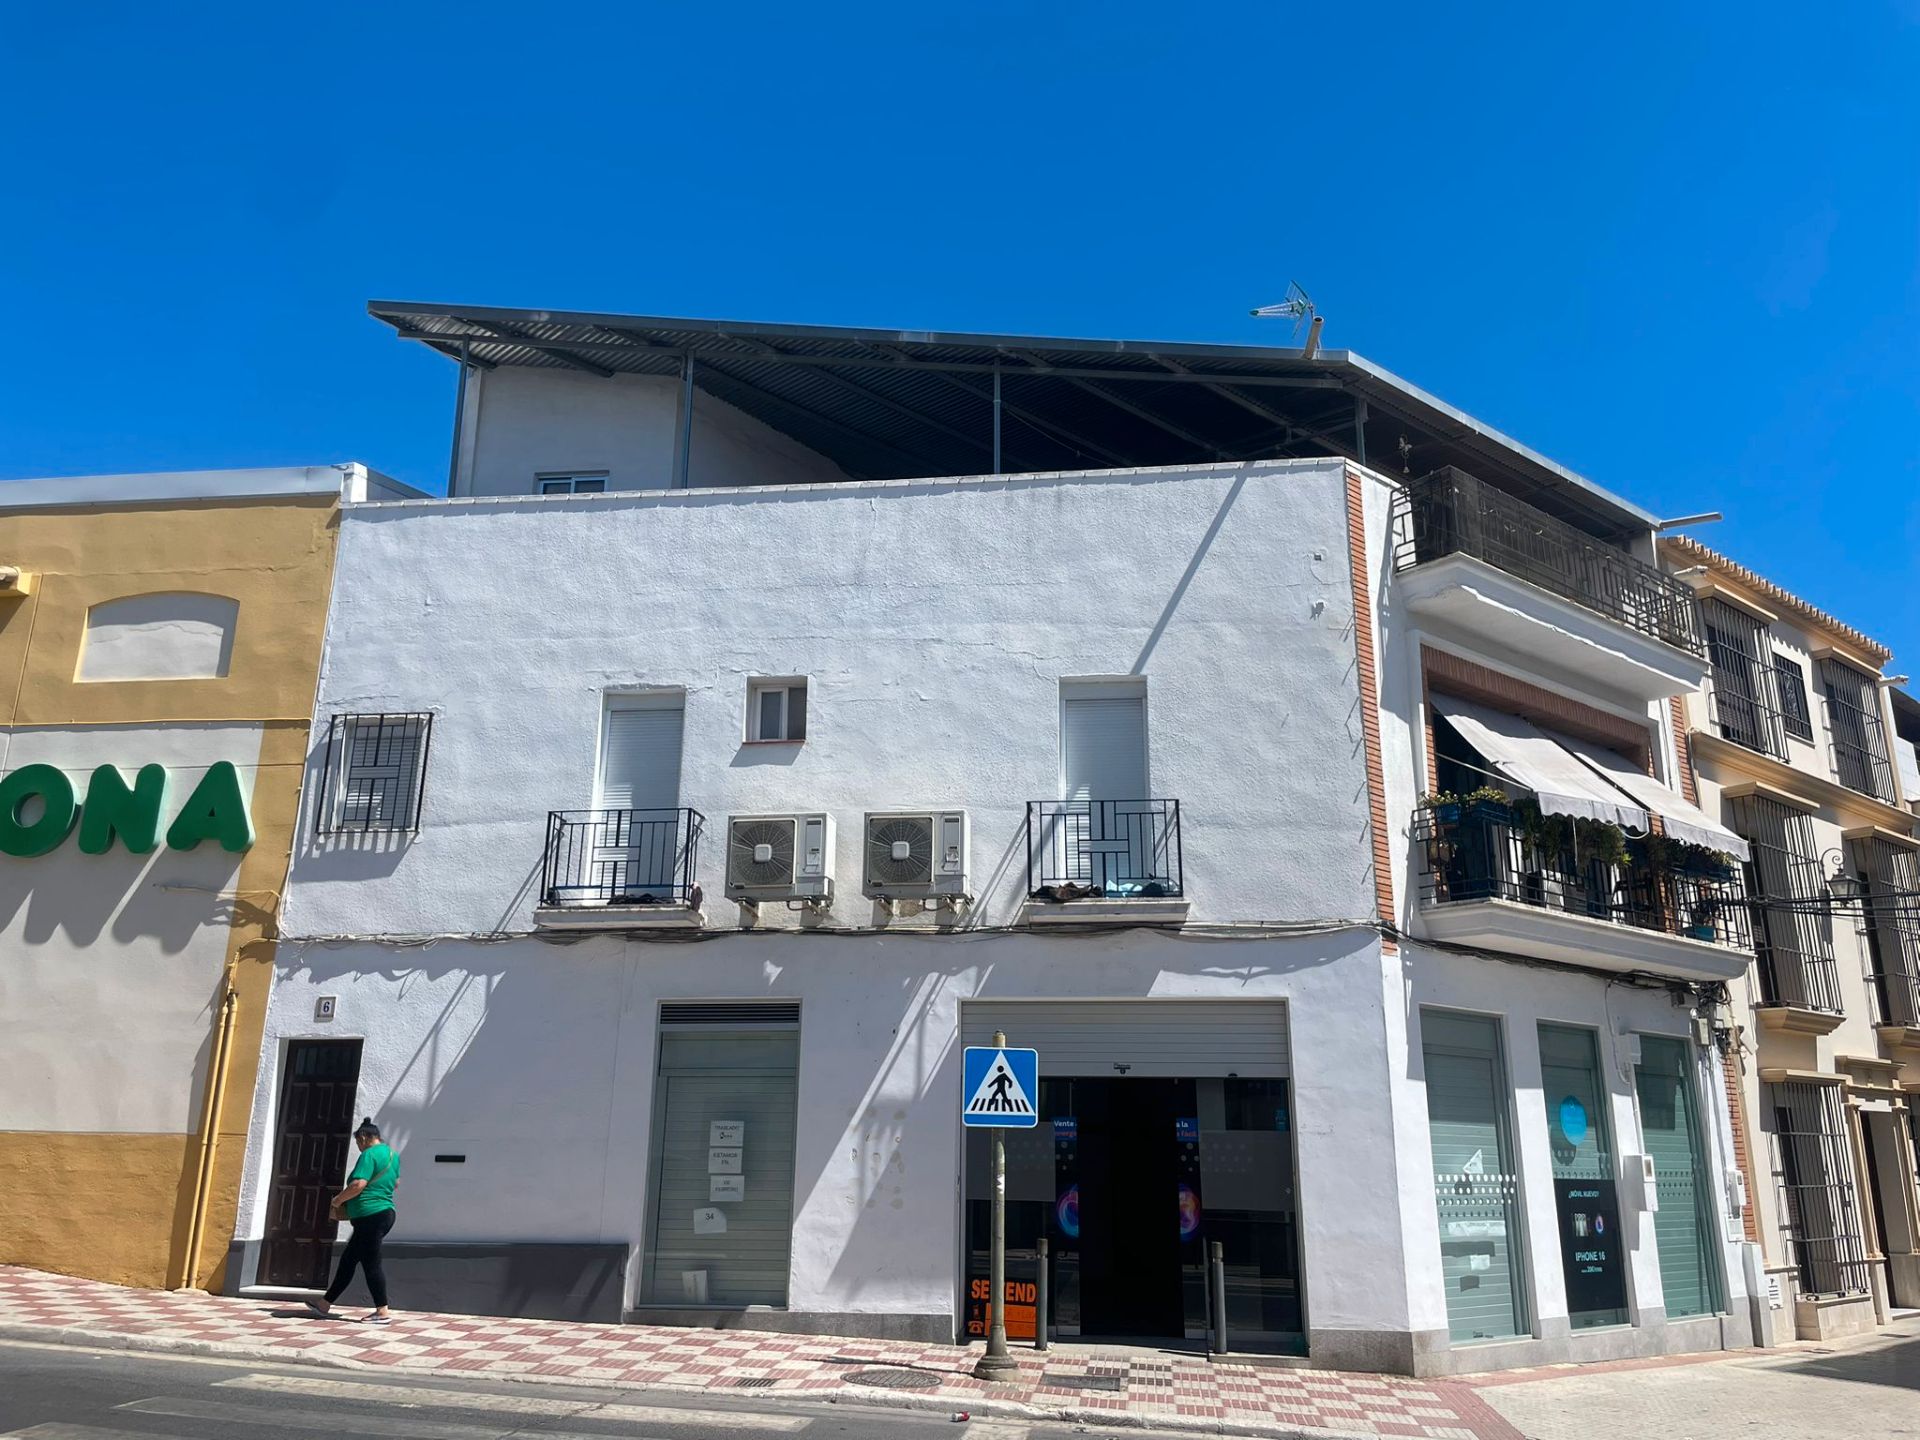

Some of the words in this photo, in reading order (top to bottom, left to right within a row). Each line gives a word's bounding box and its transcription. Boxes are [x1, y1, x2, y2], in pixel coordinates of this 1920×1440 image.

[0, 761, 256, 857] ONA
[323, 1001, 330, 1013] 6
[1053, 1120, 1075, 1128] Vente
[1575, 1251, 1598, 1262] IPHONE
[1599, 1251, 1606, 1261] 16
[971, 1279, 990, 1299] SE
